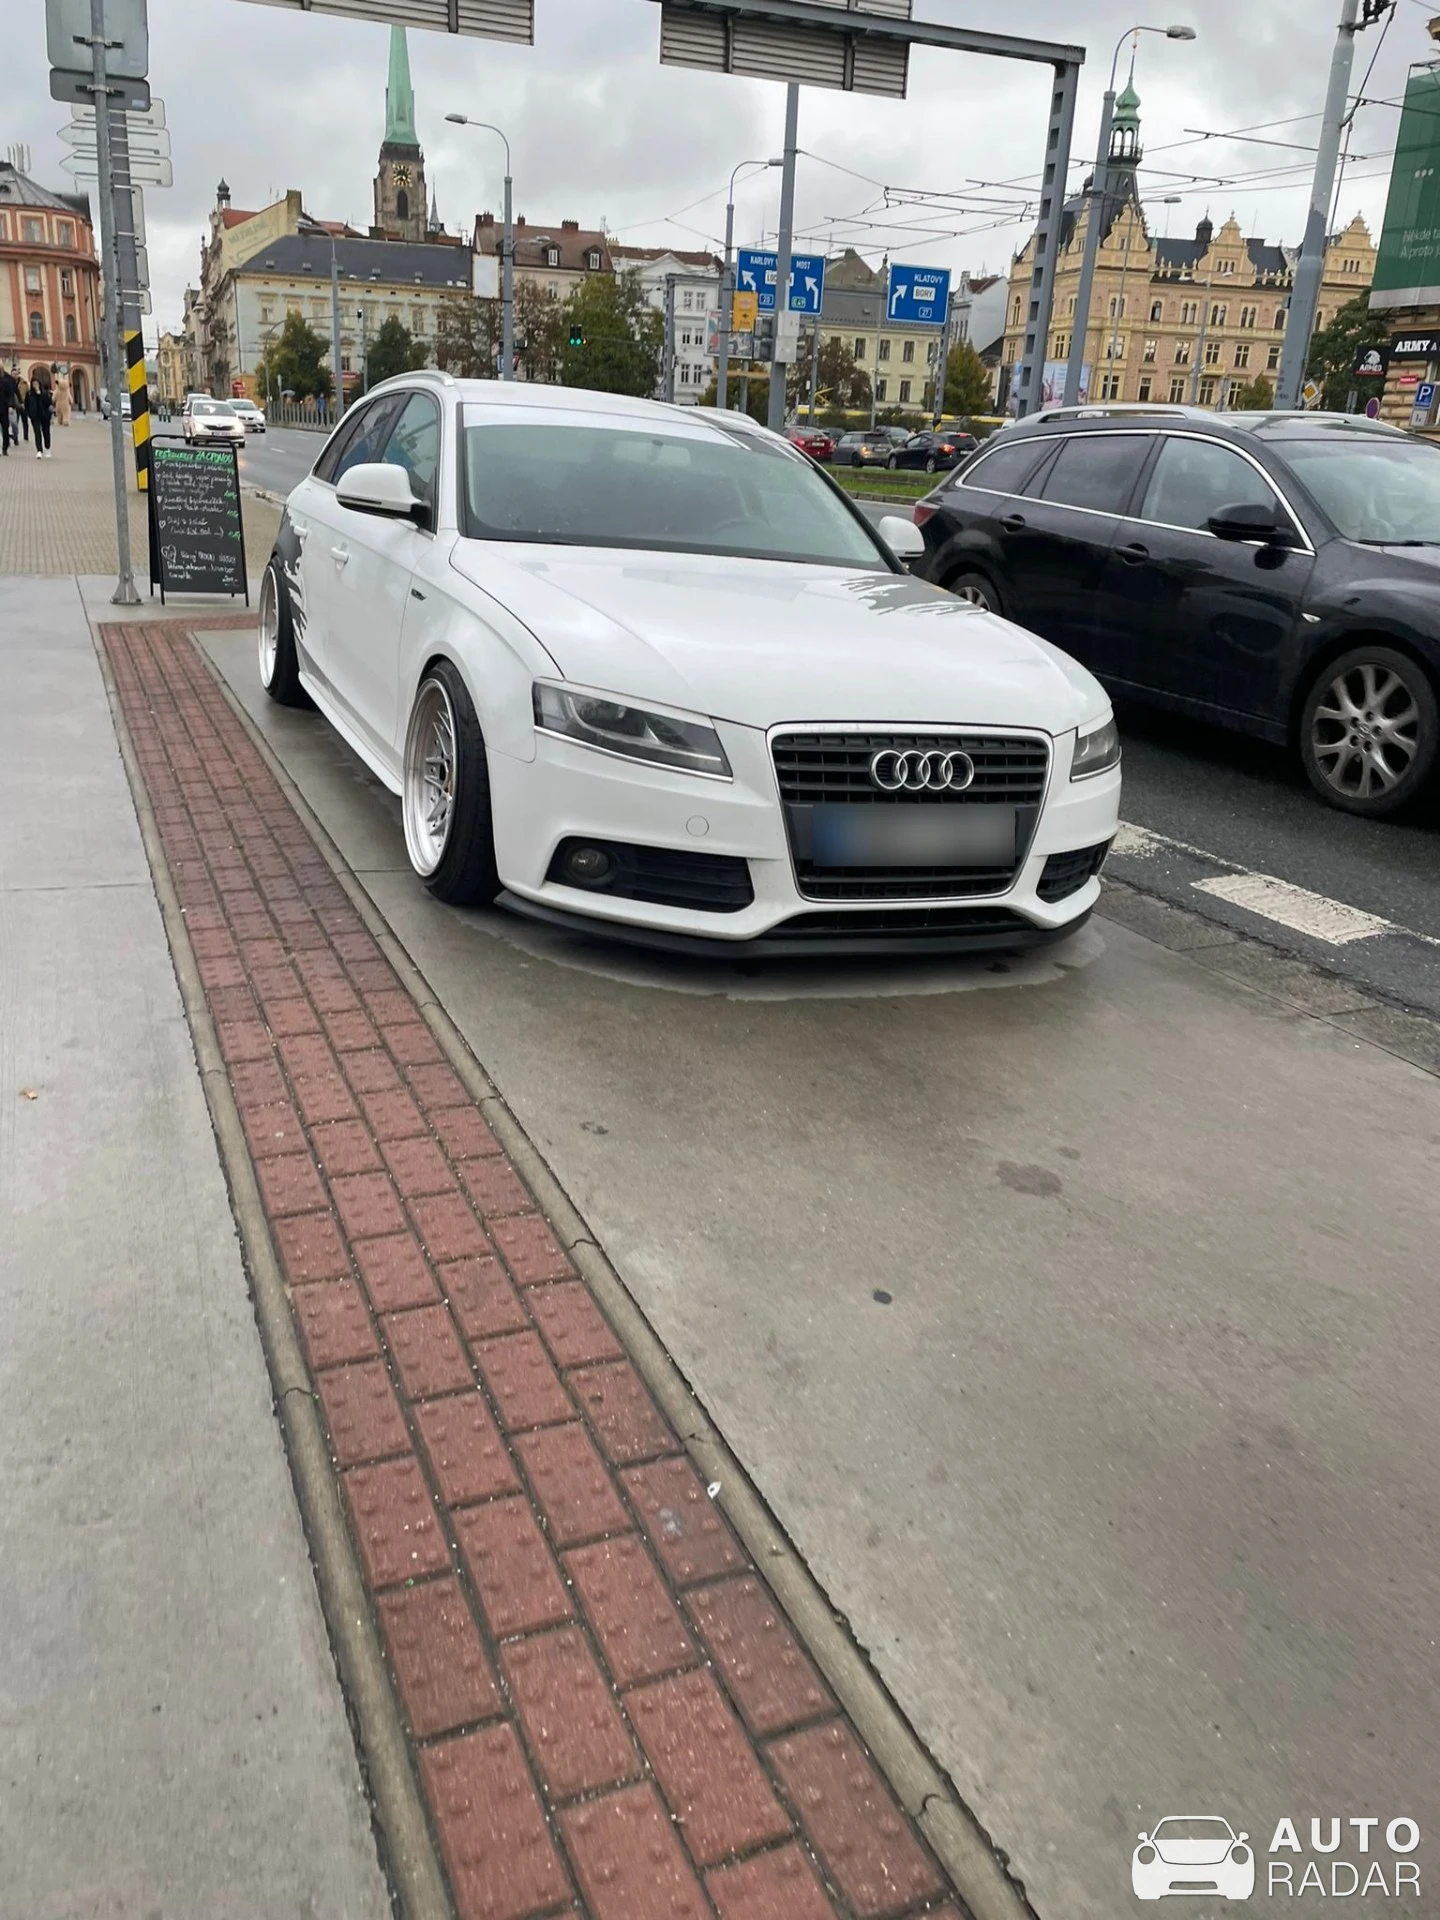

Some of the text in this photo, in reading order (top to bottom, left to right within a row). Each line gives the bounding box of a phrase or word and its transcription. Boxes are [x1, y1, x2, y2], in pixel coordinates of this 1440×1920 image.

[750, 255, 774, 266] KARLOVY
[796, 260, 811, 270] MOST
[914, 273, 943, 284] KLATOVY
[915, 288, 934, 298] BORY
[1394, 340, 1431, 353] ARMY
[1418, 386, 1431, 400] P
